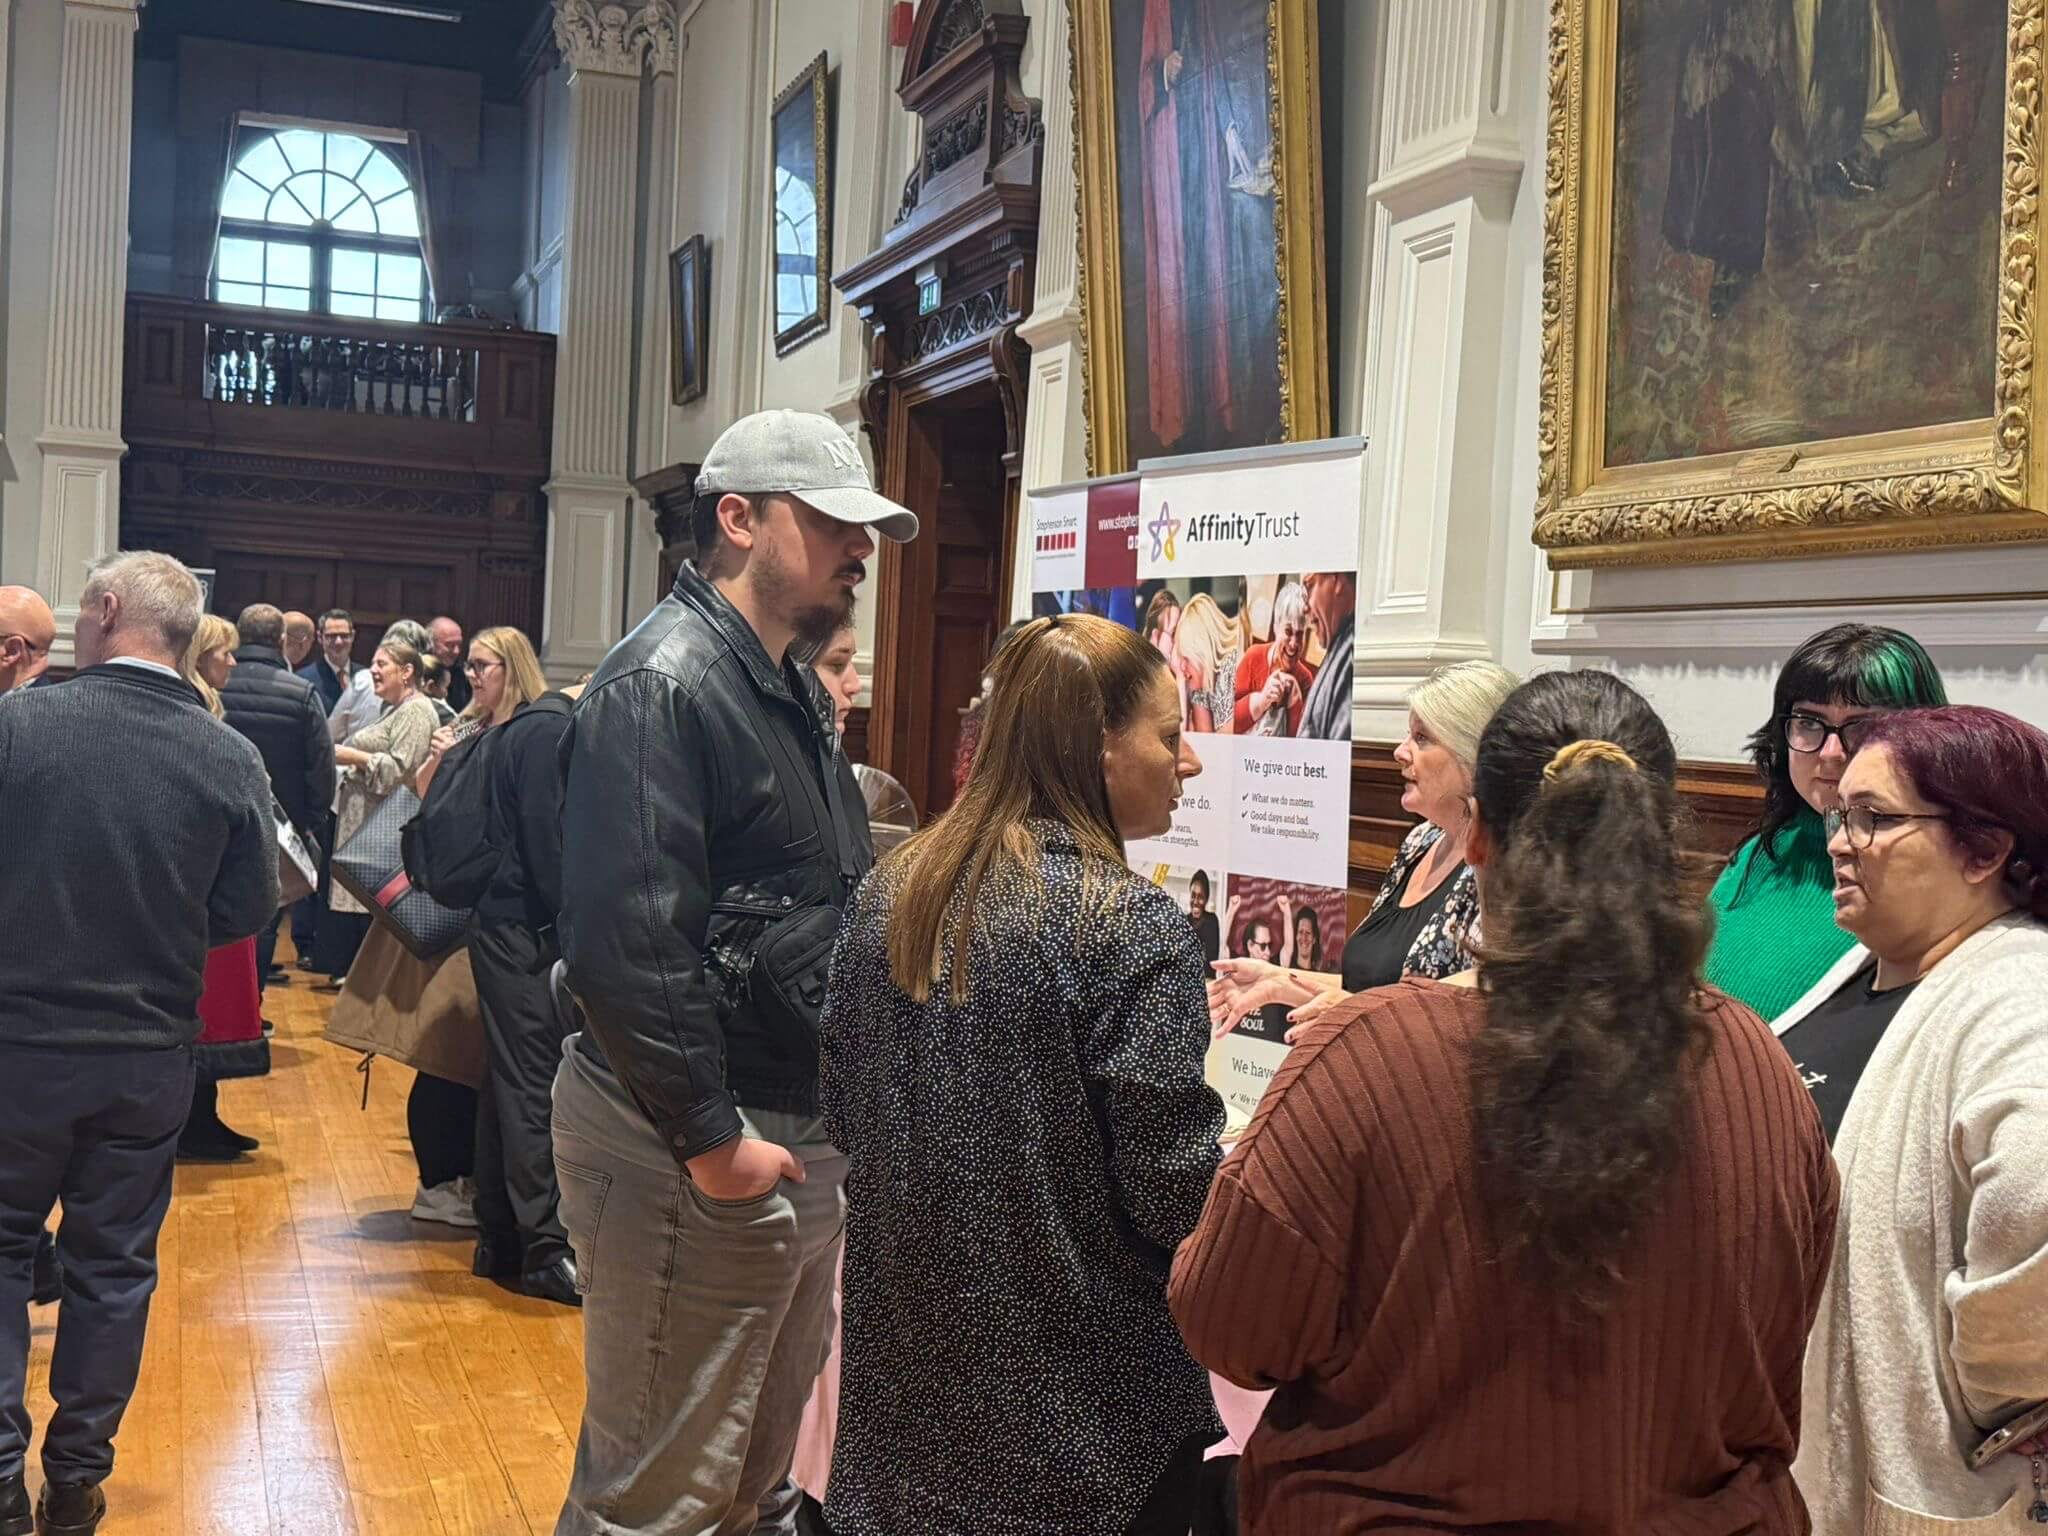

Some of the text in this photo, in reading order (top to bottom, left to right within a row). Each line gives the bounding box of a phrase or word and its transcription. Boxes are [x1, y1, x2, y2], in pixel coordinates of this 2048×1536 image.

[1186, 511, 1300, 546] AffinityTrust
[1244, 758, 1328, 779] We give our best.
[1181, 795, 1212, 810] we do.
[1252, 793, 1315, 808] What we do matters.
[1250, 811, 1267, 821] Good
[1268, 812, 1282, 824] days
[1283, 816, 1295, 824] and
[1250, 824, 1261, 834] We
[1262, 825, 1275, 835] take
[1232, 1057, 1249, 1074] We
